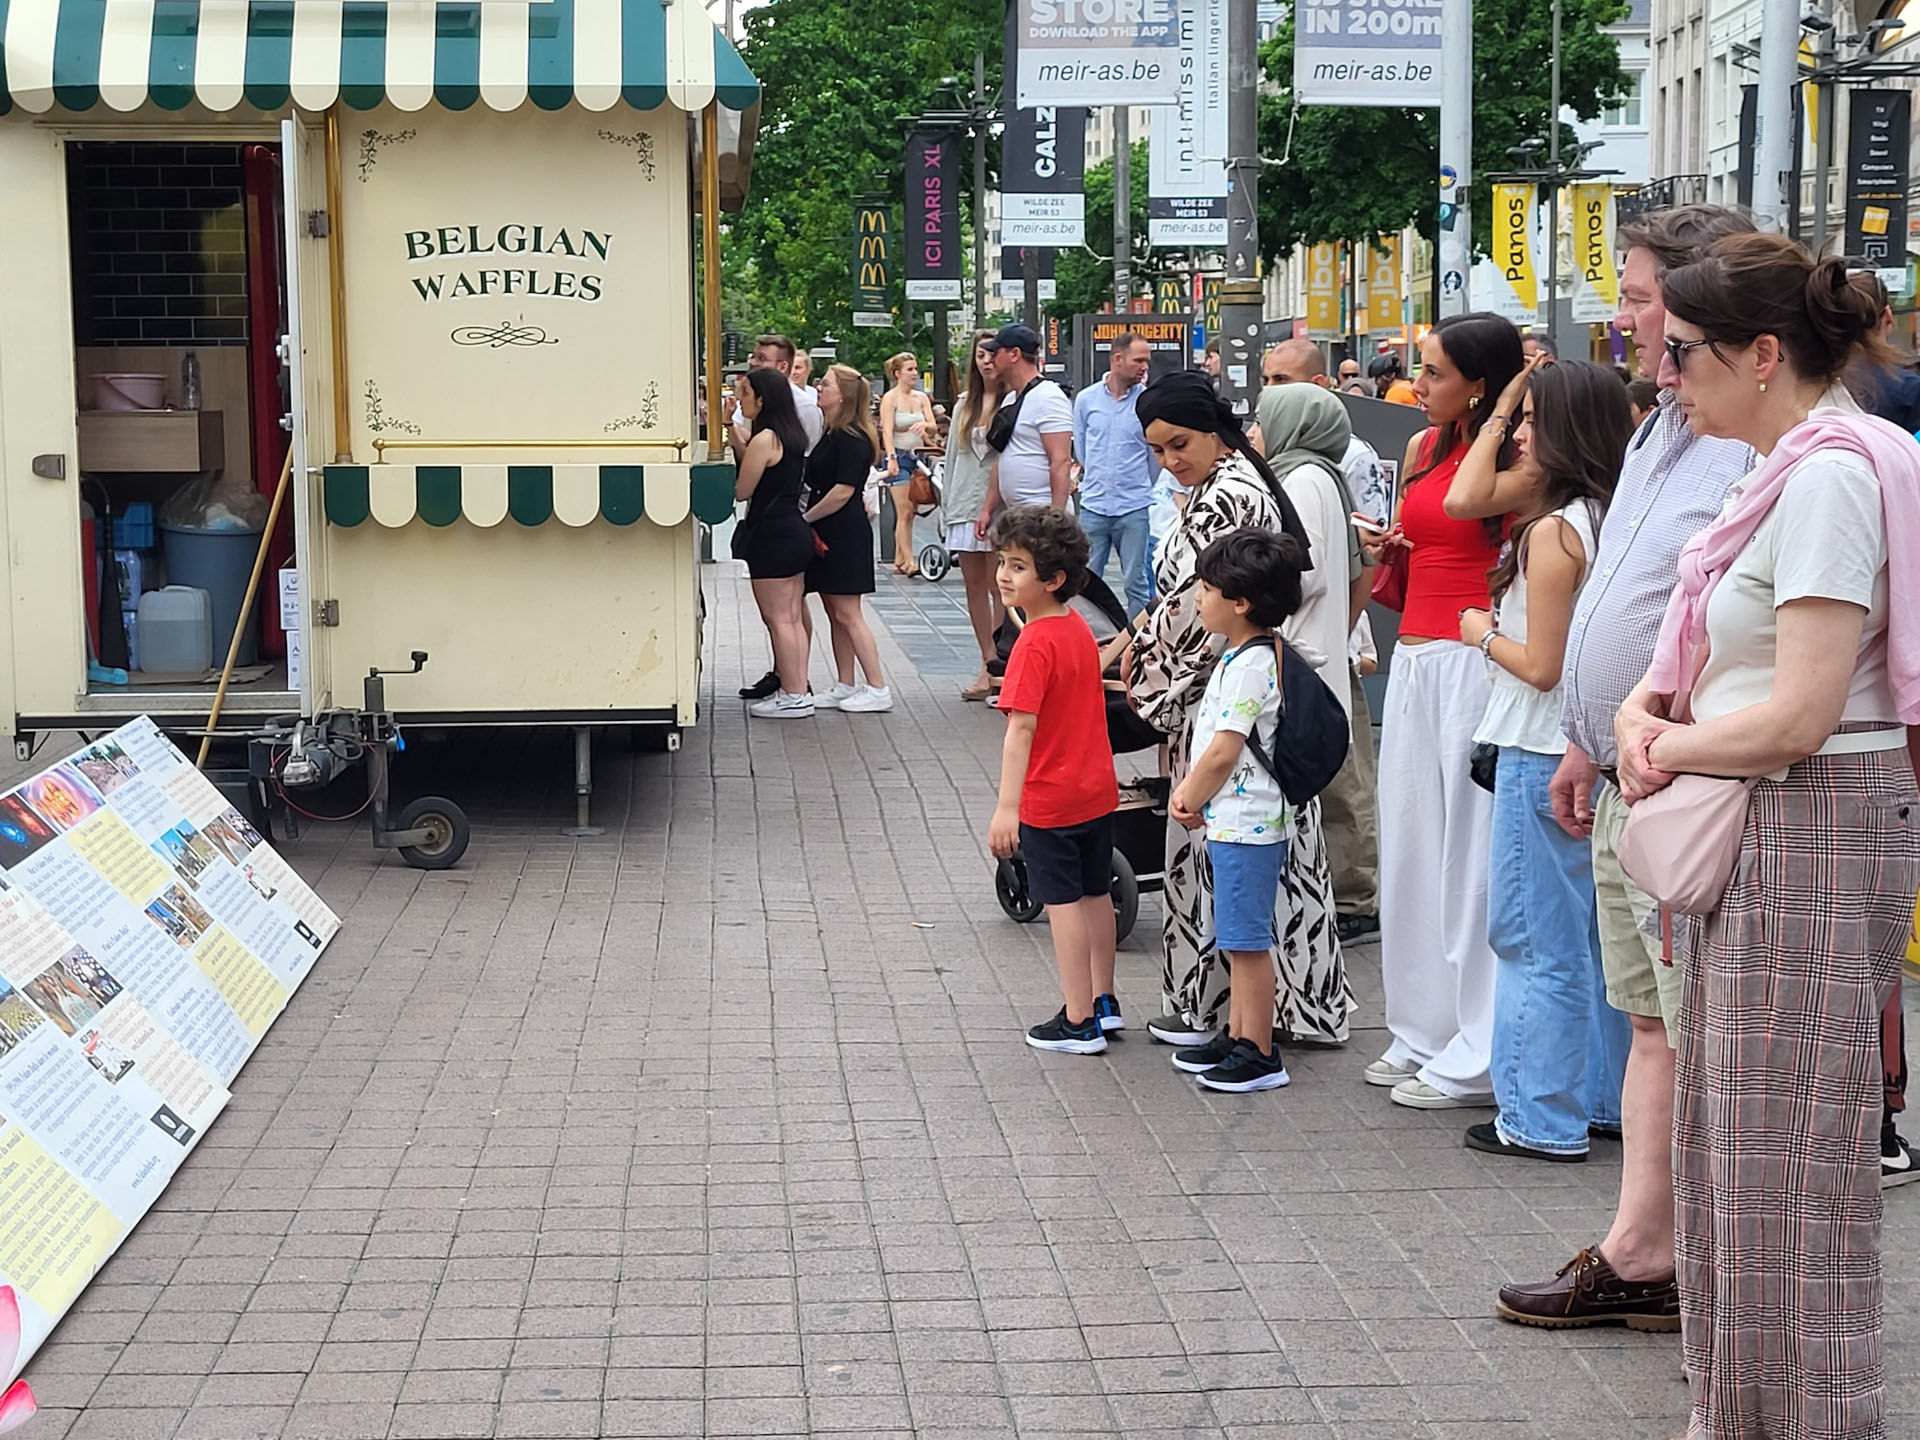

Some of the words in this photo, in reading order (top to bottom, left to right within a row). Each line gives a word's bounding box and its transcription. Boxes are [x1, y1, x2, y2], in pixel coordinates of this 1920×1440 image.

[1030, 0, 1170, 24] STORE
[1304, 8, 1341, 34] IN
[1347, 10, 1442, 35] 200m
[1029, 26, 1109, 38] DOWNLOAD
[1111, 26, 1139, 38] THE
[1141, 25, 1169, 37] APP
[1038, 58, 1161, 82] meir-as.be
[1313, 60, 1433, 82] meir-as.be
[1179, 9, 1194, 173] intimissimi
[1207, 61, 1220, 110] Italian
[925, 143, 942, 169] XL
[925, 176, 942, 234] PARIS
[1023, 199, 1049, 207] WILDE
[1050, 199, 1066, 207] ZEE
[1028, 208, 1049, 217] MEIR
[1169, 199, 1197, 208] WILDE
[1198, 199, 1214, 208] ZEE
[1176, 209, 1197, 218] MEIR
[1012, 222, 1076, 234] meir-as.be
[1160, 221, 1224, 233] meir-as.be
[1506, 197, 1524, 281] Panos
[404, 224, 614, 262] BELGIAN
[1586, 200, 1604, 282] Panos
[925, 245, 942, 268] ICI
[411, 269, 602, 302] WAFFLES
[1094, 323, 1127, 340] JOHN
